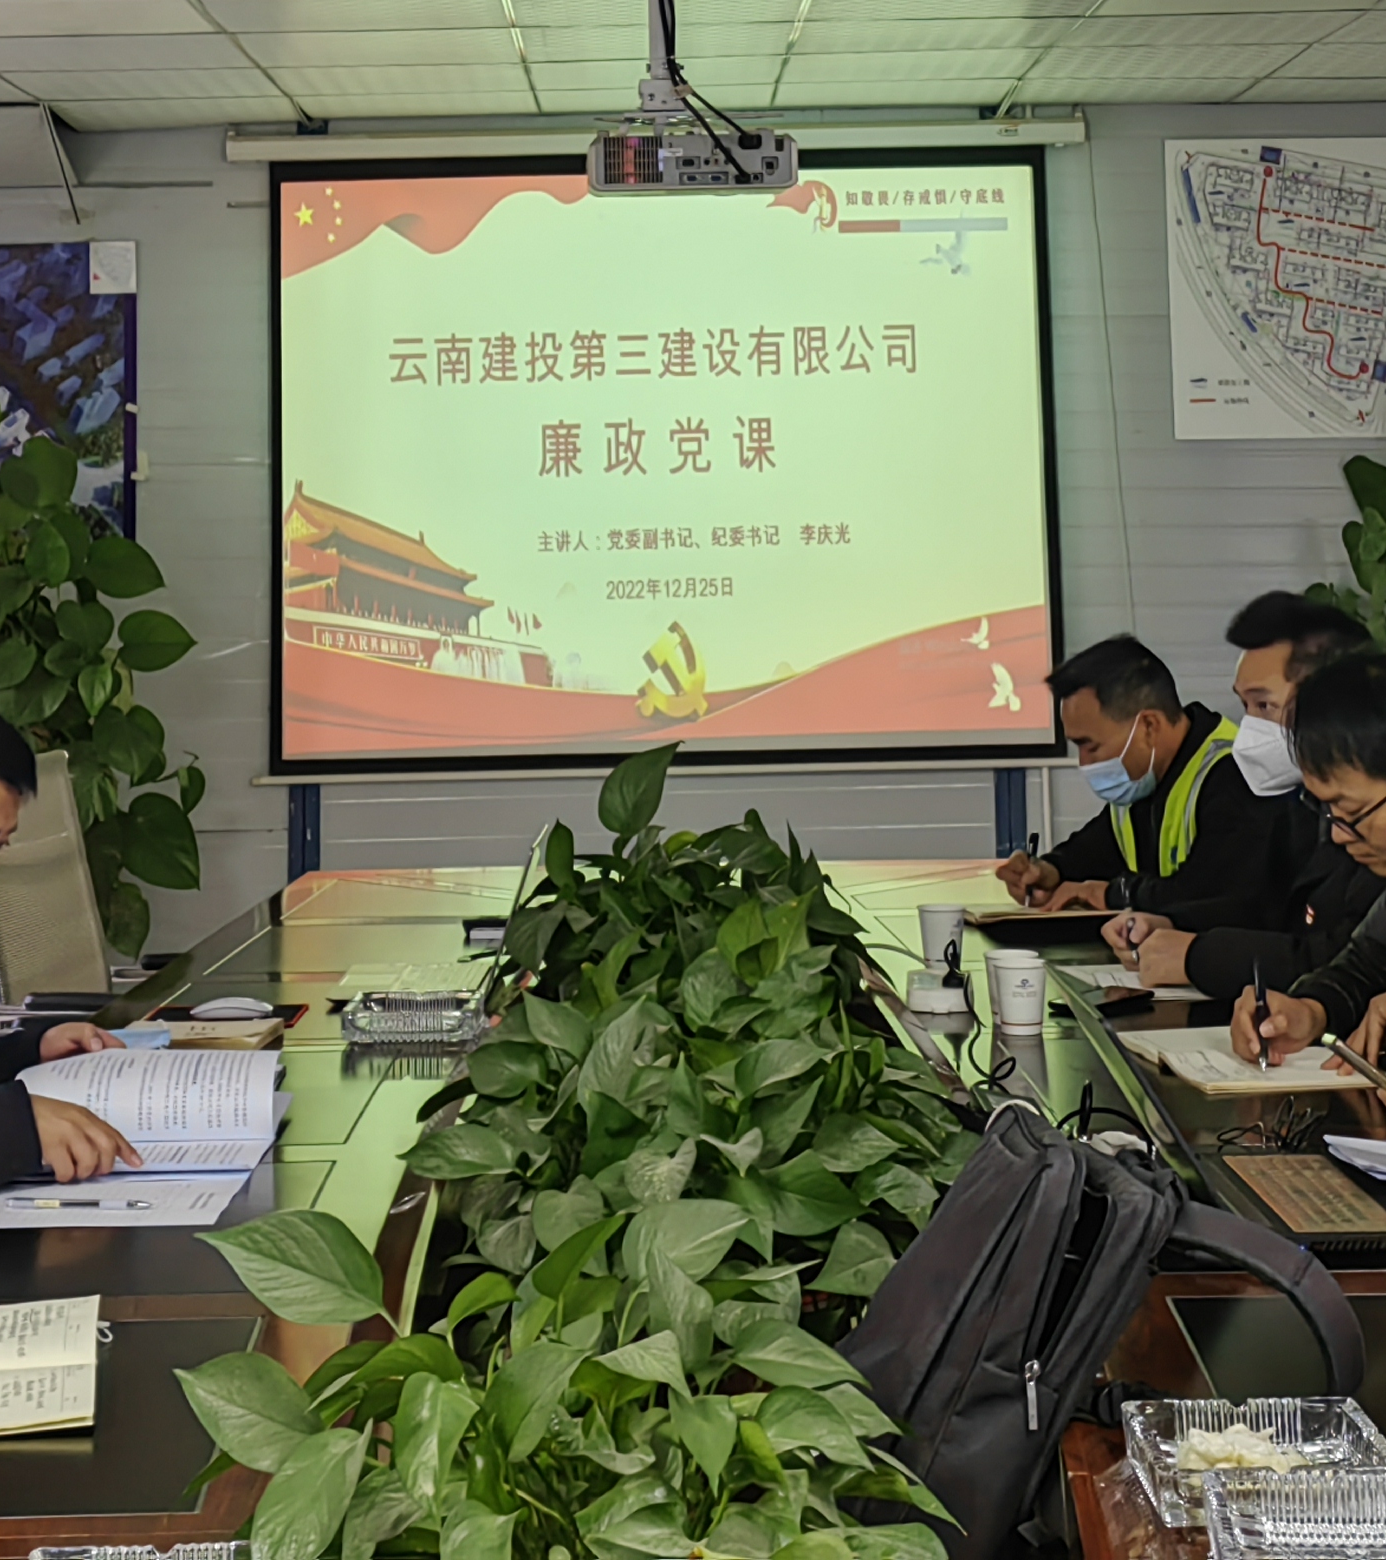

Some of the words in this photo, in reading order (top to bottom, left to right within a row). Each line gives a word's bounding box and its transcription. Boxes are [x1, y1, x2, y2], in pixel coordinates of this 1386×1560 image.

[388, 323, 918, 387] 云南建投第三建设有限公司
[538, 415, 777, 479] 廉政党课
[606, 577, 734, 600] 2022年12月25日
